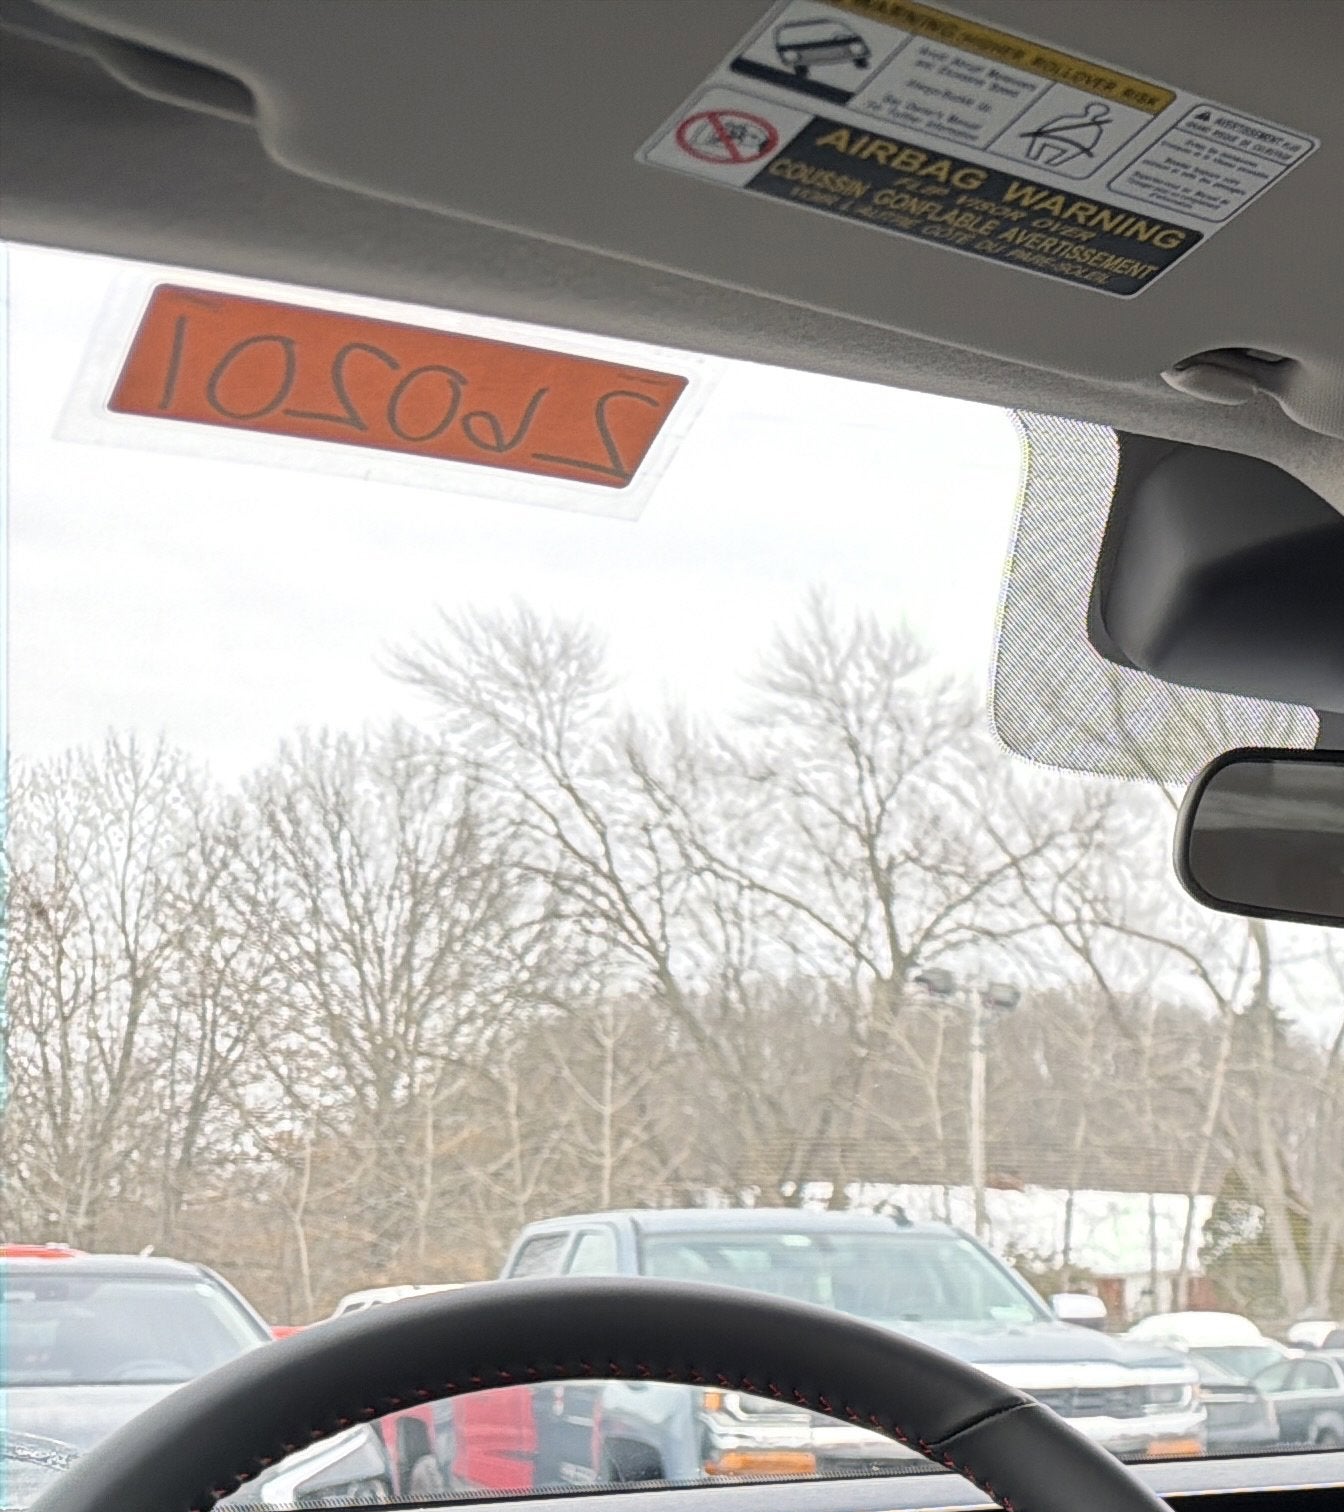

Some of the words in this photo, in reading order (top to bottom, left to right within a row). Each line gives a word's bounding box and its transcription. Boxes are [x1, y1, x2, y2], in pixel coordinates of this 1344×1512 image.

[768, 158, 872, 199] COUSSIN
[998, 226, 1160, 280] AVERTISSEMENT
[816, 128, 988, 190] AIRBAG
[1003, 181, 1187, 249] WARNING
[956, 194, 1028, 222] VISOR
[1032, 218, 1097, 241] OVER
